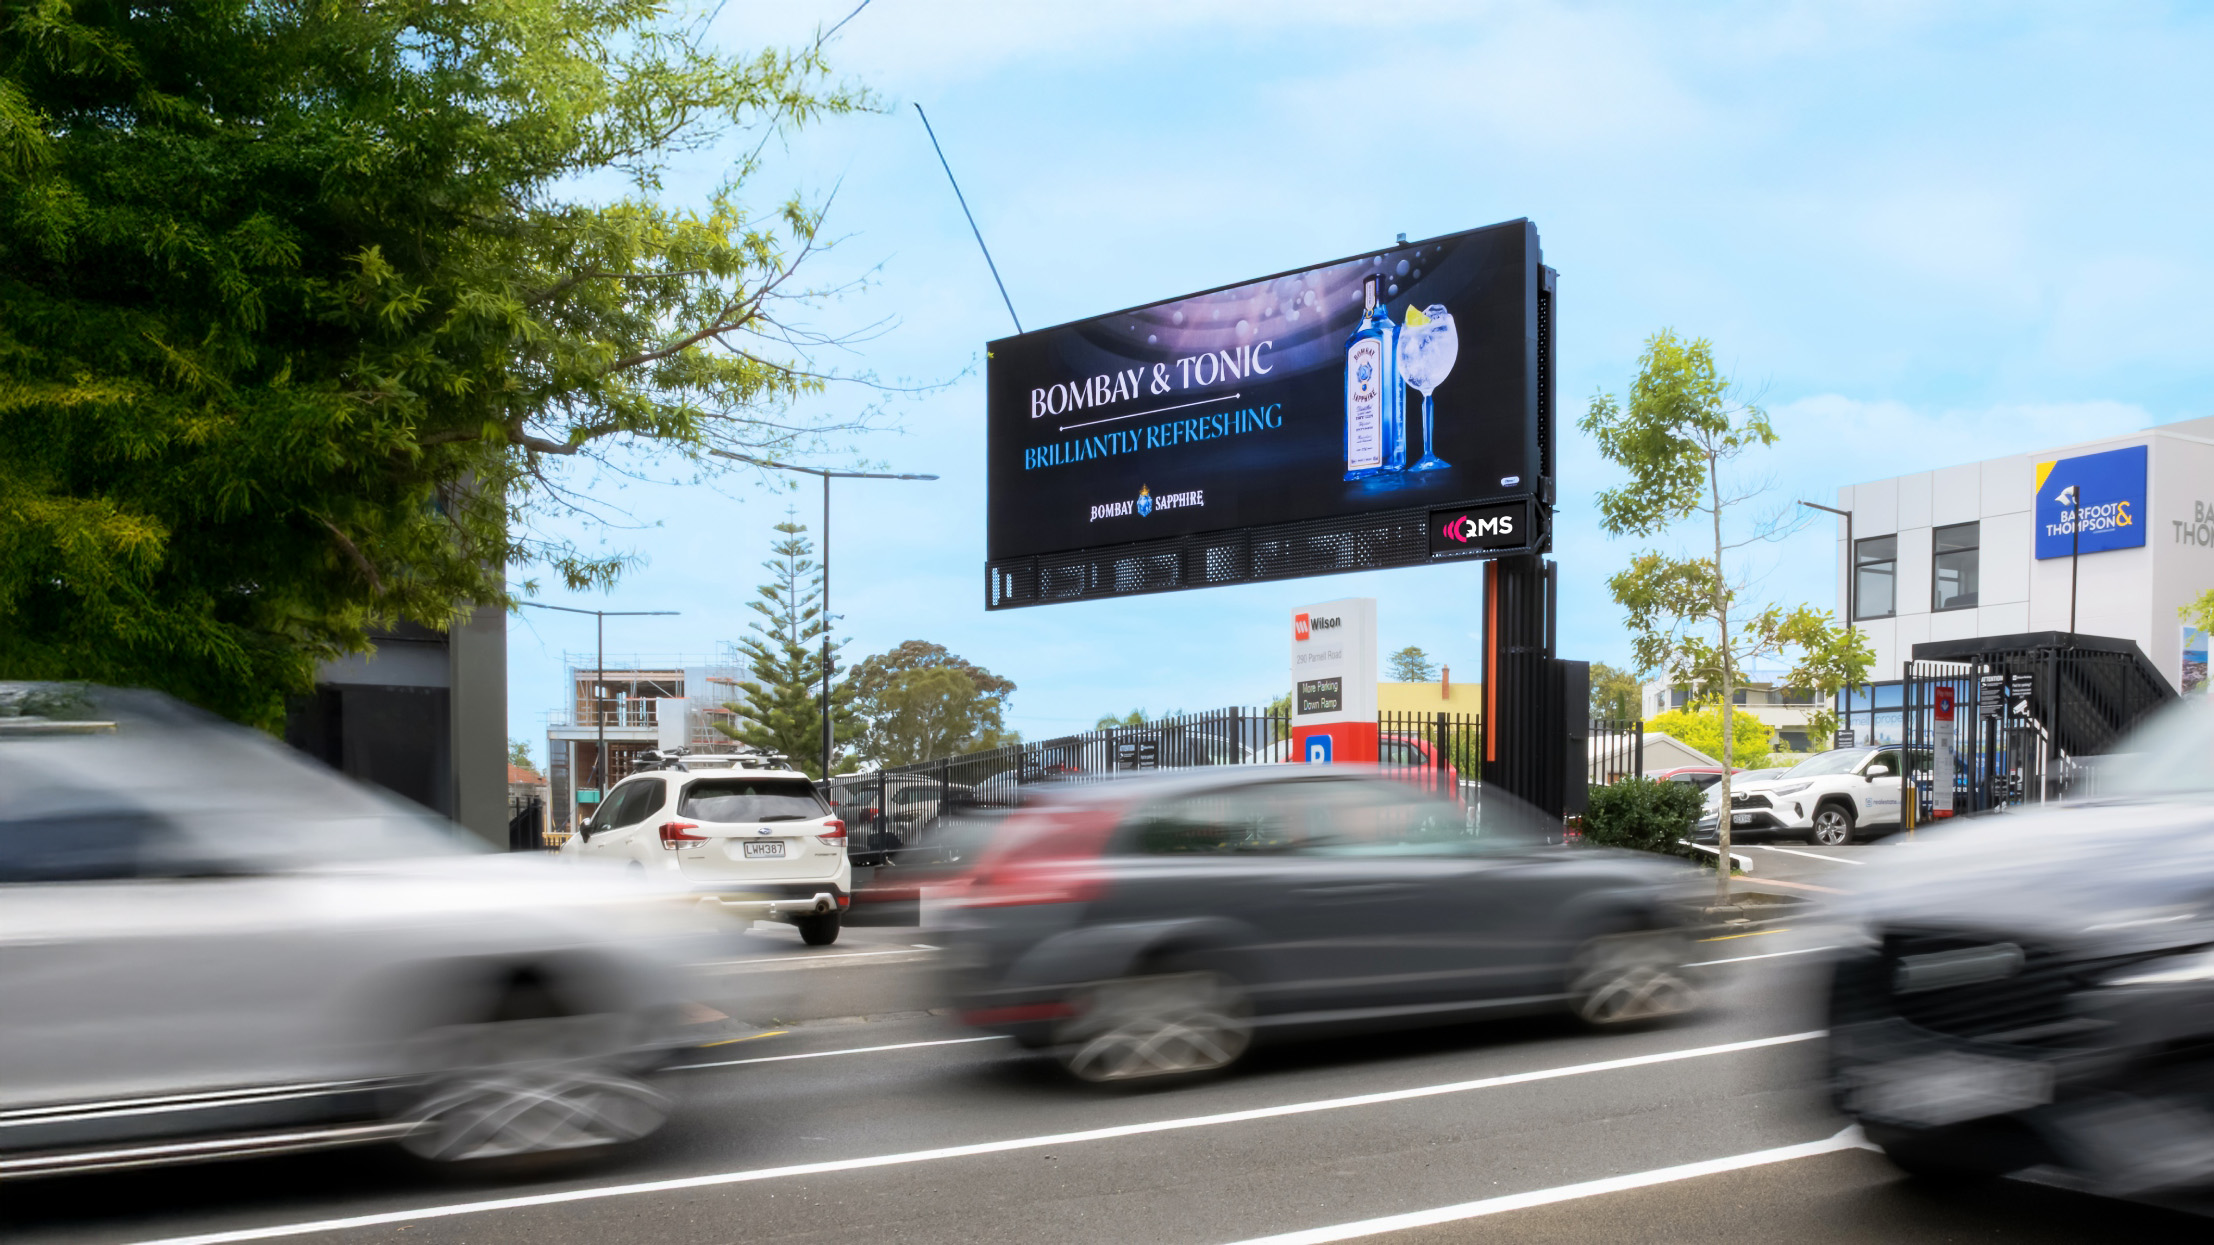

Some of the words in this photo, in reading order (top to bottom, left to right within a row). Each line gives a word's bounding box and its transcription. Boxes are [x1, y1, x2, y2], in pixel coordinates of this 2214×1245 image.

[1031, 366, 1145, 418] BOMBAY
[1150, 362, 1171, 395] &
[1176, 341, 1273, 389] TONIC
[1025, 428, 1142, 470] BRILLIANTLY
[1146, 403, 1282, 449] REFRESHING
[1090, 500, 1134, 522] BOMBAY
[1155, 490, 1204, 511] SAPPHIRE
[2060, 503, 2118, 523] BARFOOT
[2115, 501, 2133, 527] &
[1454, 515, 1514, 543] QMS
[2046, 515, 2116, 537] THOMPSON
[1310, 616, 1341, 631] Wilson
[1327, 650, 1343, 661] Road
[1302, 682, 1317, 694] More
[1317, 680, 1339, 693] Parking
[1303, 699, 1320, 711] Down
[1320, 697, 1338, 709] Ramp
[1310, 744, 1326, 765] P
[746, 844, 783, 855] LWH387
